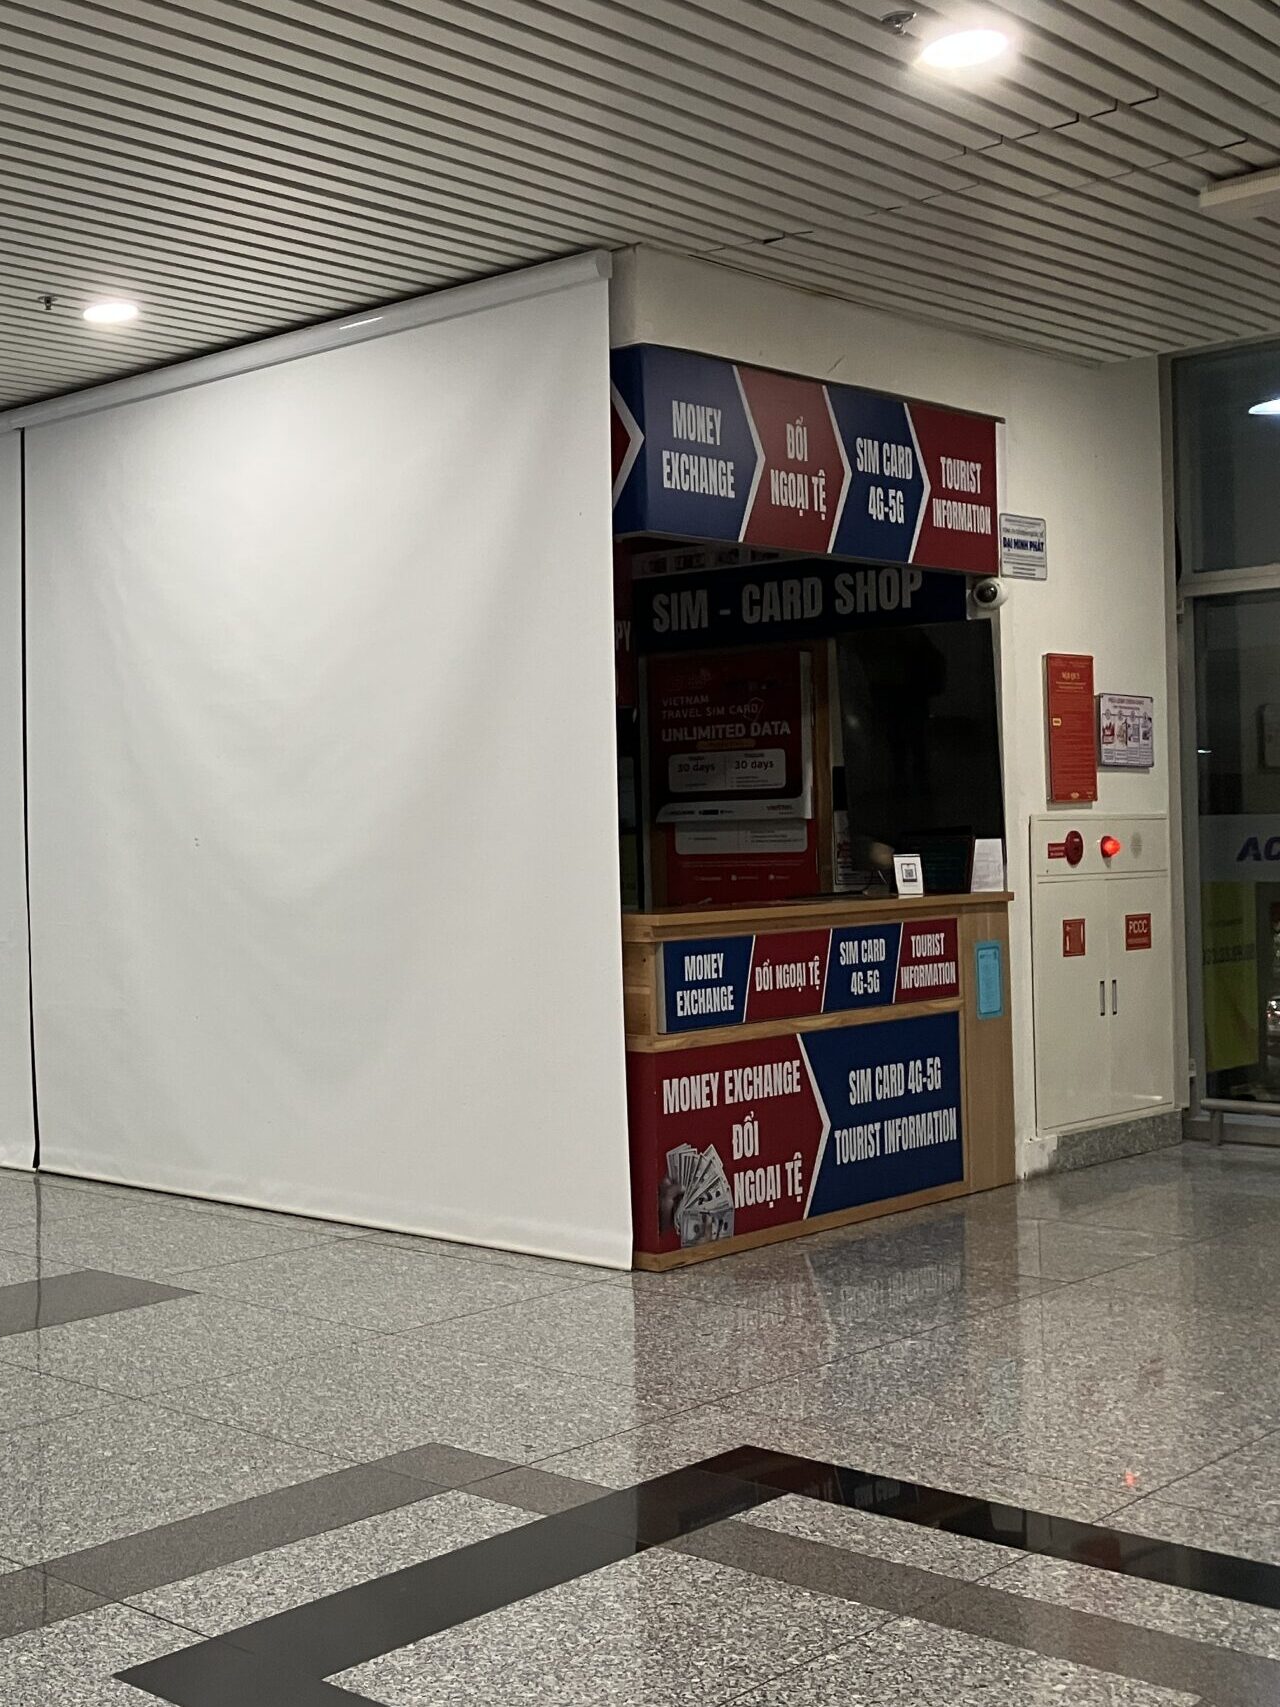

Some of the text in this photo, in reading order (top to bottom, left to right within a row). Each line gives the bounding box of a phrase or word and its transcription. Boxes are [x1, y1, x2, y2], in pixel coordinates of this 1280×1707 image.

[672, 400, 722, 446] MONEY
[786, 416, 809, 462] ĐỔI
[662, 450, 736, 499] EXCHANGE
[855, 437, 913, 480] SIM CARD
[940, 456, 982, 494] TOURIST
[770, 469, 827, 521] NGOẠI TỆ
[868, 486, 905, 524] 4G-5G
[932, 498, 992, 535] INFORMATION
[651, 589, 710, 633] SIM
[740, 577, 824, 625] CARD
[834, 568, 923, 616] SHOP
[661, 694, 709, 707] VIETNAM
[661, 703, 759, 720] TRAVEL SIM CARD
[661, 720, 792, 742] UNLIMITED DATA
[692, 761, 716, 774] days
[751, 759, 775, 771] days
[911, 932, 945, 958] TOURIST
[1128, 920, 1148, 934] PCCC
[684, 953, 724, 982] MONEY
[840, 938, 886, 966] SIM CARD
[755, 955, 820, 992] ĐỔI NGOẠI TỆ
[850, 969, 880, 996] 4G-5G
[900, 961, 957, 990] INFORMATION
[676, 985, 734, 1017] EXCHANGE
[663, 1059, 802, 1115] MONEY EXCHANGE
[848, 1056, 941, 1106] SIM CARD 4G-5G
[732, 1110, 760, 1161] ĐỔI
[834, 1107, 957, 1166] TOURIST INFORMATION
[733, 1152, 803, 1209] NGOẠI TỆ
